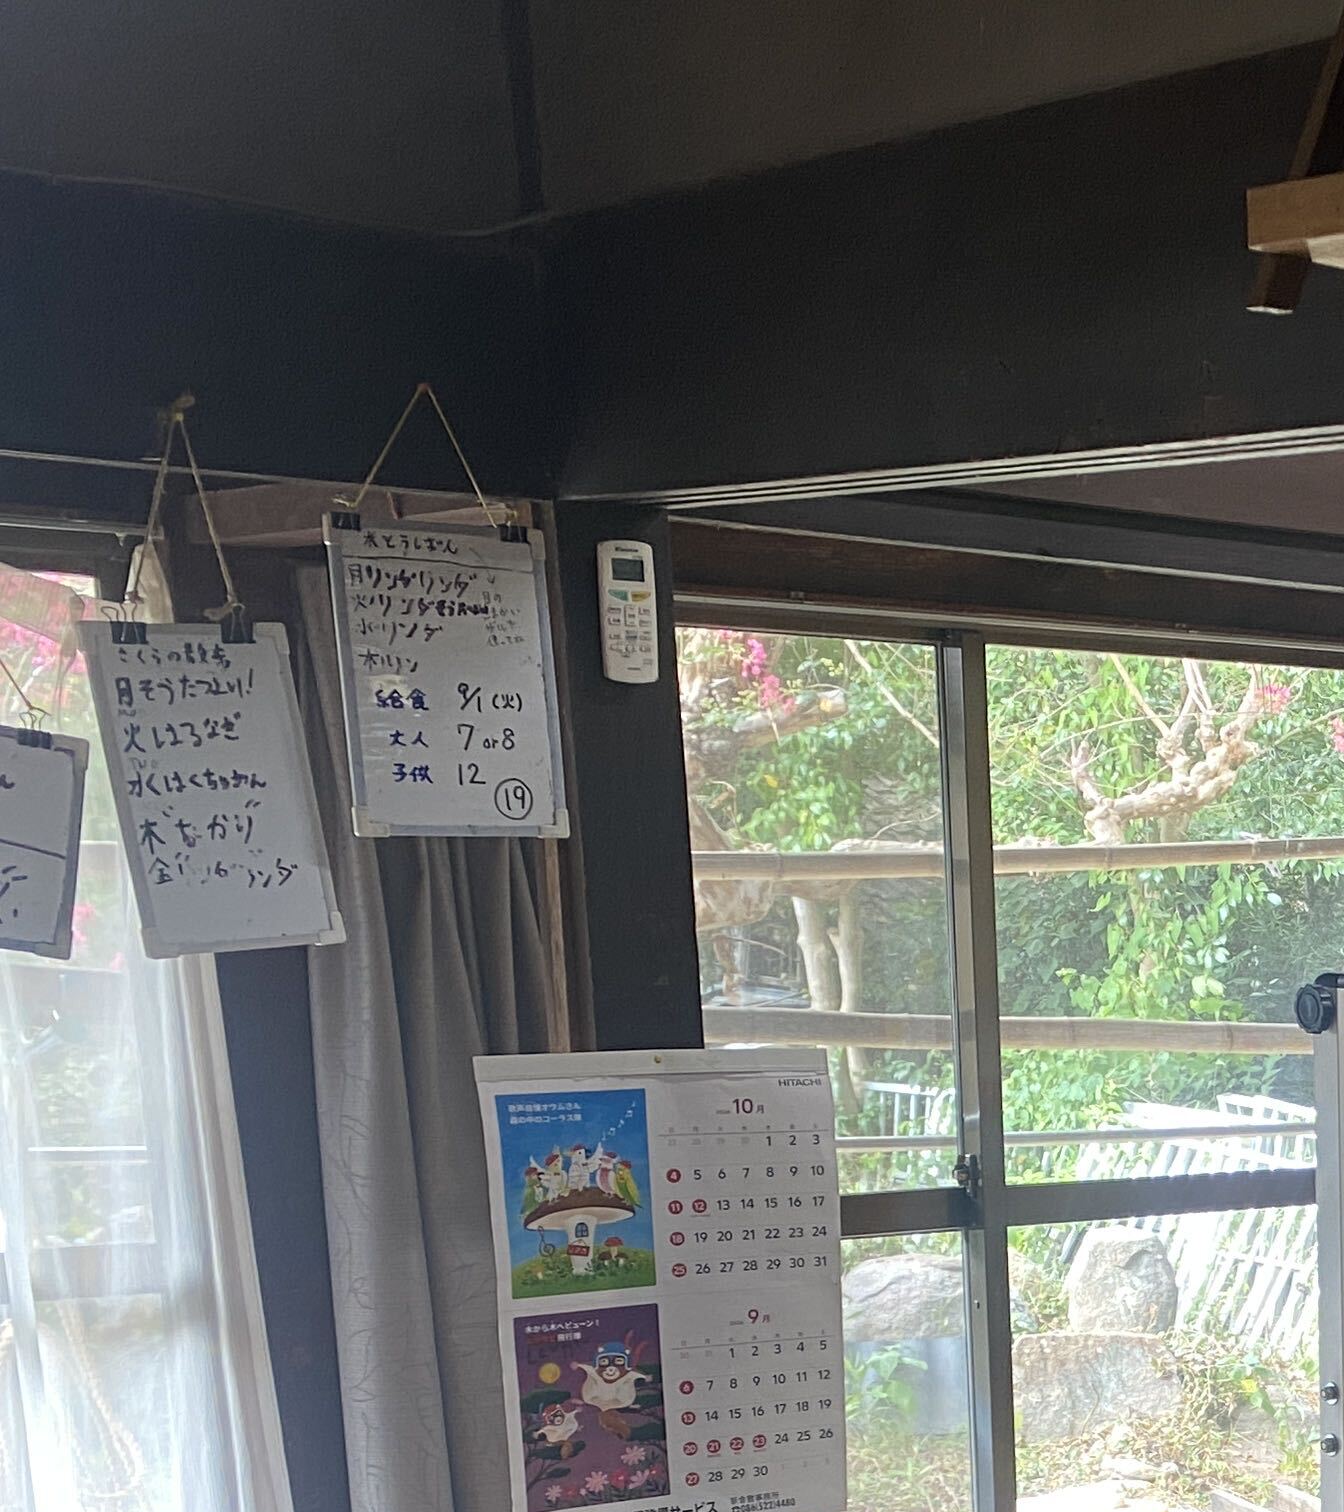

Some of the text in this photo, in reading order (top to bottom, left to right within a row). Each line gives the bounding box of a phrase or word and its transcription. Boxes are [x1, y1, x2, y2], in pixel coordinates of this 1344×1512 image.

[375, 688, 429, 711] 給食
[389, 730, 429, 747] 大人
[392, 763, 486, 785] 子供 12
[778, 1078, 822, 1086] HITACHI
[789, 1135, 796, 1145] 2
[813, 1134, 820, 1145] 3
[694, 1169, 701, 1180] 5
[718, 1169, 726, 1179] 6
[743, 1168, 749, 1178] 7
[767, 1167, 774, 1177] 8
[790, 1166, 797, 1176] 9
[811, 1165, 824, 1176] 10
[718, 1200, 730, 1210] 13
[741, 1199, 754, 1209] 14
[765, 1198, 777, 1208] 15
[789, 1197, 801, 1207] 16
[813, 1196, 824, 1206] 17
[695, 1232, 707, 1242] 19
[717, 1231, 732, 1241] 20
[742, 1230, 755, 1240] 21
[765, 1229, 780, 1239] 22
[789, 1228, 803, 1238] 23
[812, 1227, 827, 1237] 24
[696, 1264, 710, 1274] 26
[720, 1262, 733, 1272] 27
[743, 1260, 758, 1271] 28
[767, 1259, 780, 1269] 29
[790, 1258, 804, 1268] 30
[814, 1256, 827, 1267] 31
[752, 1346, 758, 1356] 2
[774, 1344, 781, 1354] 3
[797, 1342, 804, 1352] 4
[820, 1340, 826, 1350] 5
[707, 1380, 713, 1391] 7
[730, 1379, 737, 1388] 8
[753, 1376, 760, 1386] 9
[772, 1374, 786, 1384] 10
[797, 1372, 807, 1382] 11
[818, 1370, 830, 1380] 12
[706, 1411, 719, 1421] 14
[730, 1409, 741, 1419] 15
[752, 1407, 764, 1416] 16
[775, 1404, 786, 1414] 17
[797, 1402, 808, 1412] 18
[819, 1399, 831, 1409] 19
[775, 1433, 788, 1443] 24
[797, 1431, 810, 1441] 25
[819, 1429, 833, 1439] 26
[709, 1472, 723, 1482] 28
[731, 1469, 745, 1479] 29
[753, 1466, 768, 1476] 30
